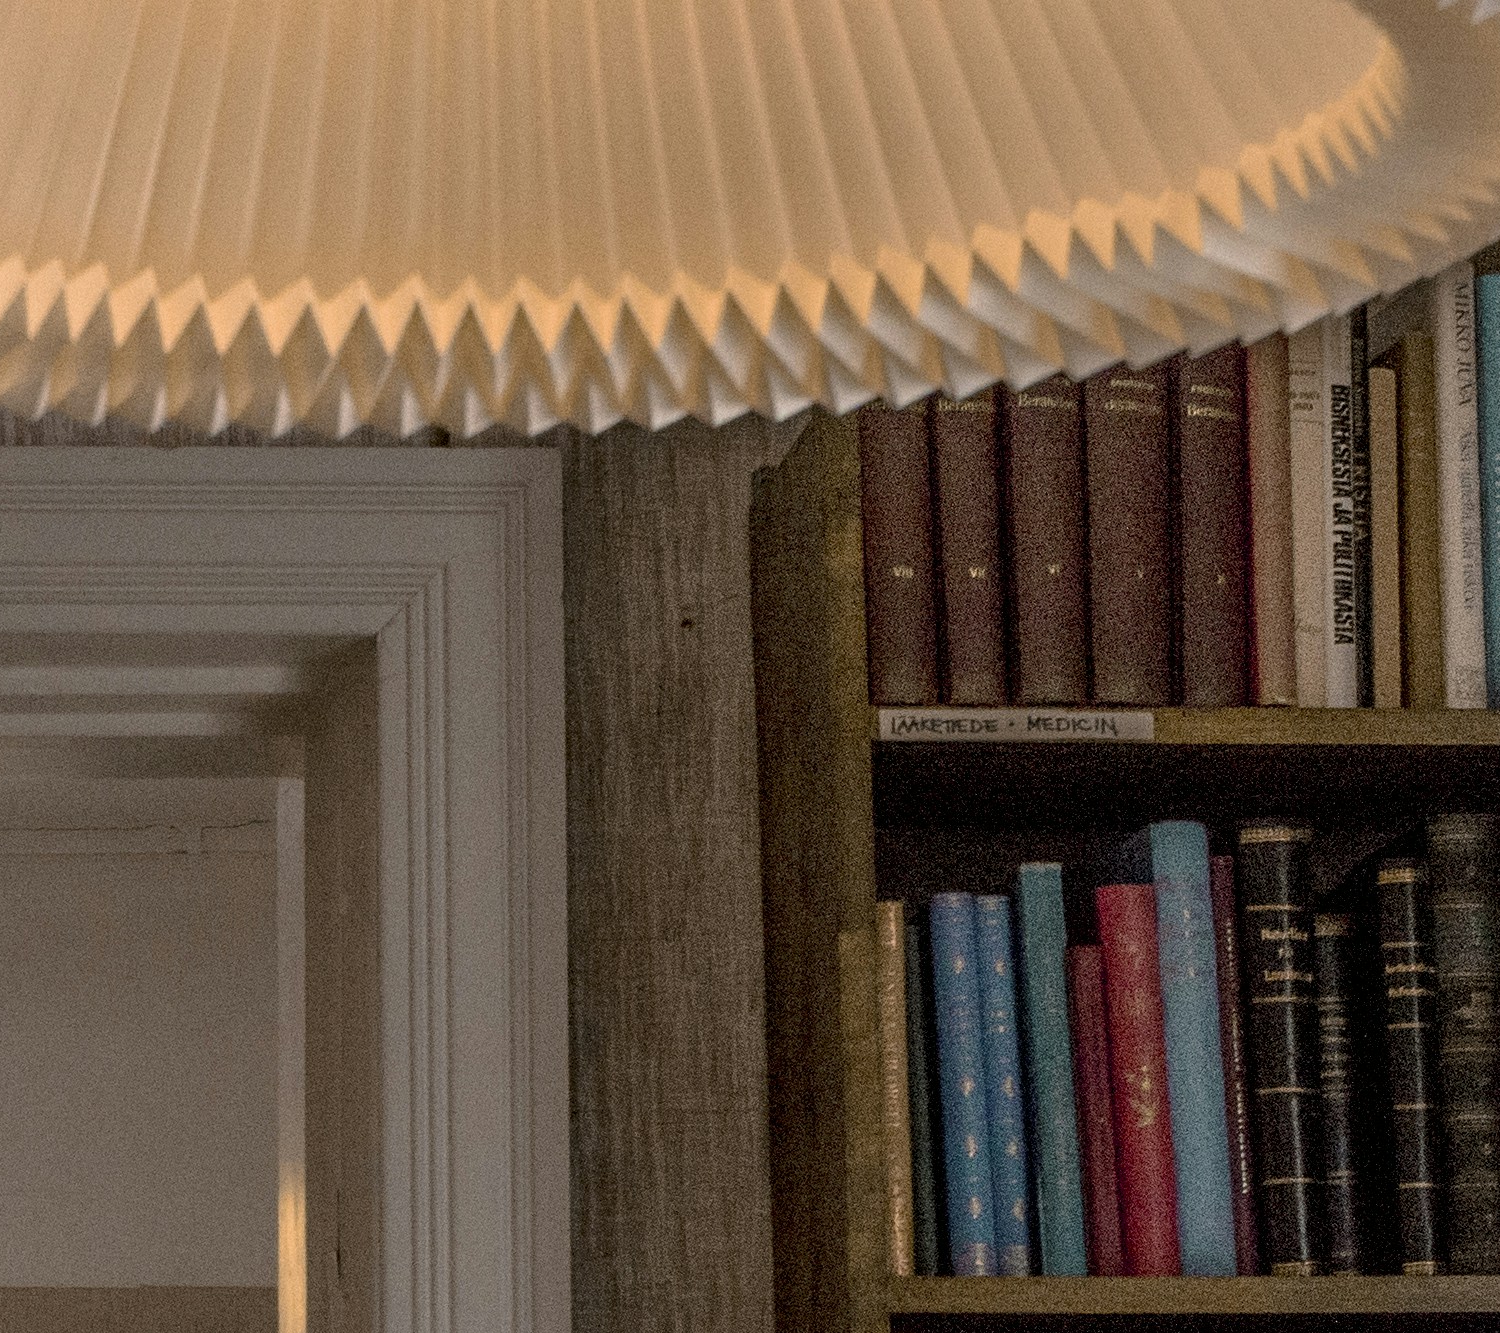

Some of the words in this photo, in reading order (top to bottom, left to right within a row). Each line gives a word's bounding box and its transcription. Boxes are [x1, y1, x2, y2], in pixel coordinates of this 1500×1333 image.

[1453, 281, 1472, 352] MIKKO
[1455, 355, 1474, 408] JUVA
[1333, 504, 1355, 528] JA
[1025, 714, 1116, 737] MEDICIN
